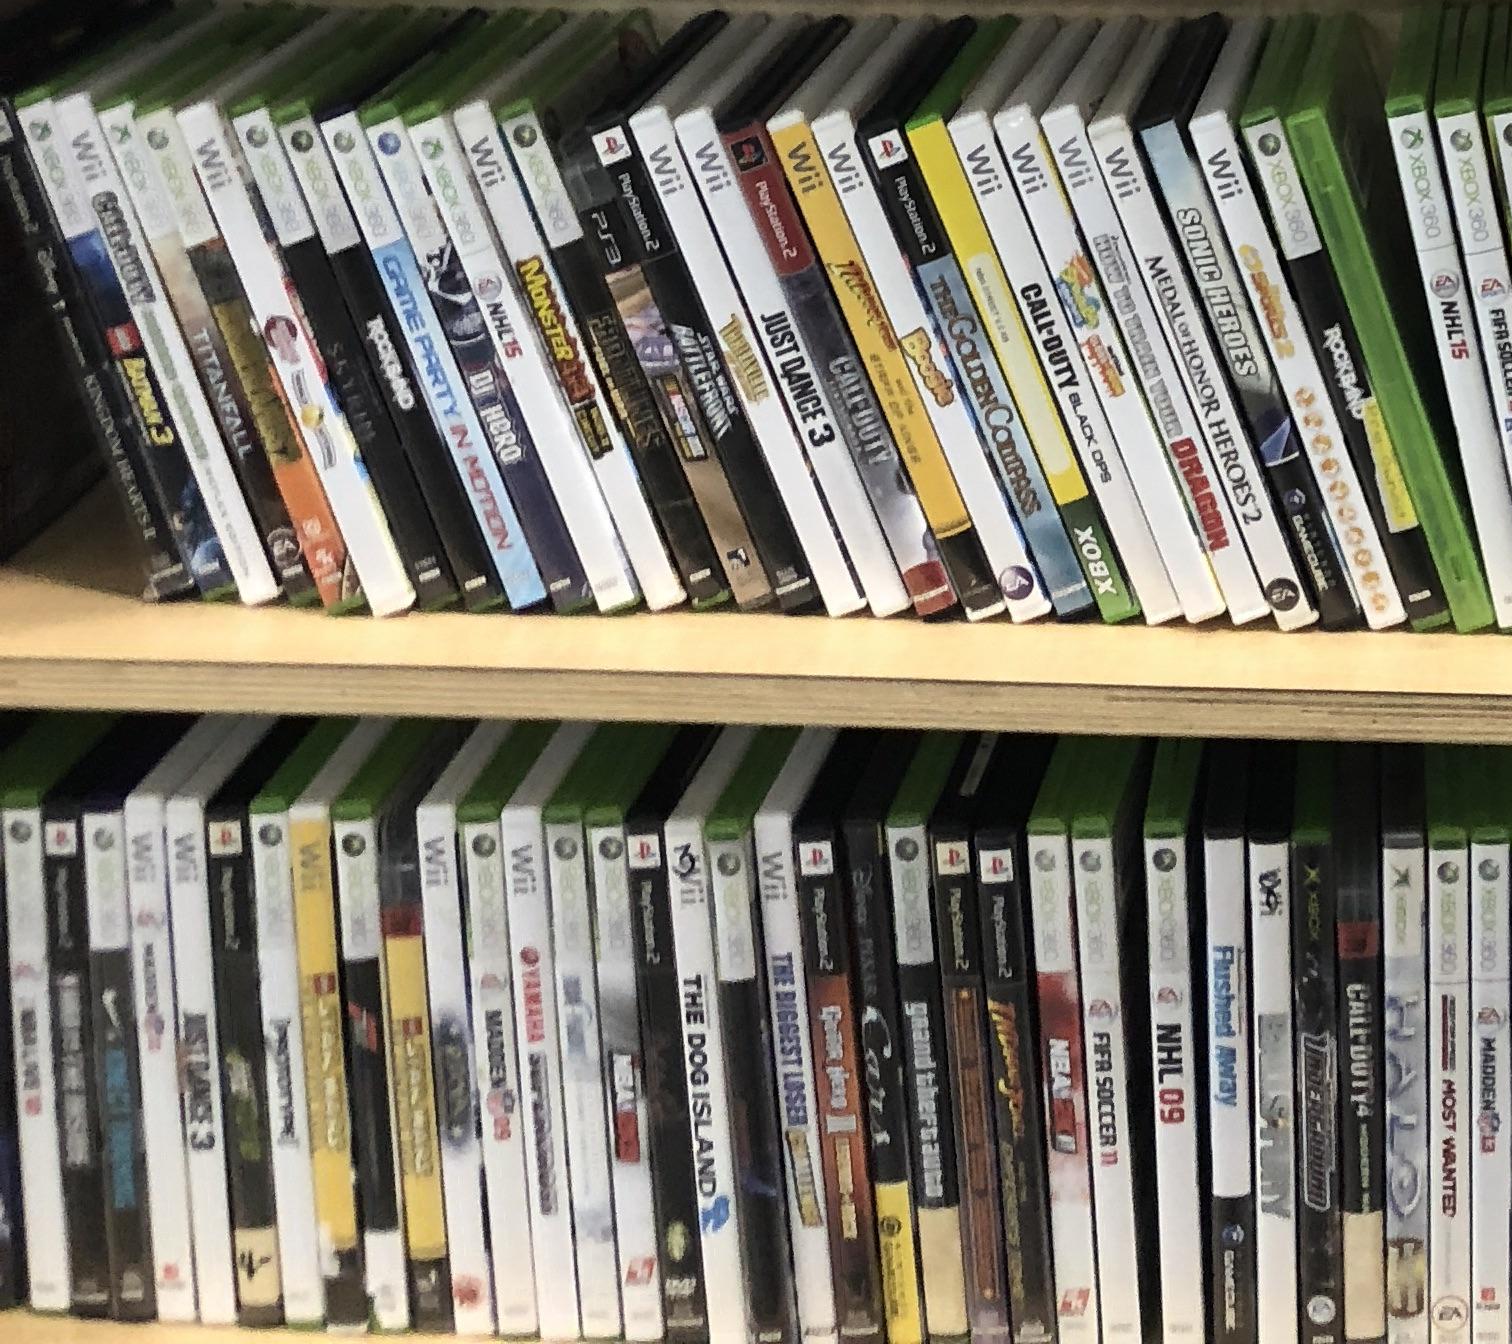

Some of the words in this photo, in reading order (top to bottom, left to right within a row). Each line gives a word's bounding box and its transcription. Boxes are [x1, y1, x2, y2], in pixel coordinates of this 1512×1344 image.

[1441, 301, 1464, 339] NHL
[1449, 339, 1469, 360] 15
[761, 312, 797, 361] JUST
[781, 359, 822, 419] DANCE
[808, 422, 835, 447] 3
[683, 975, 704, 1025] THE
[688, 1033, 709, 1089] DOG
[1156, 1023, 1182, 1084] NHL
[1159, 1088, 1184, 1123] 09
[693, 1092, 716, 1198] ISLAND
